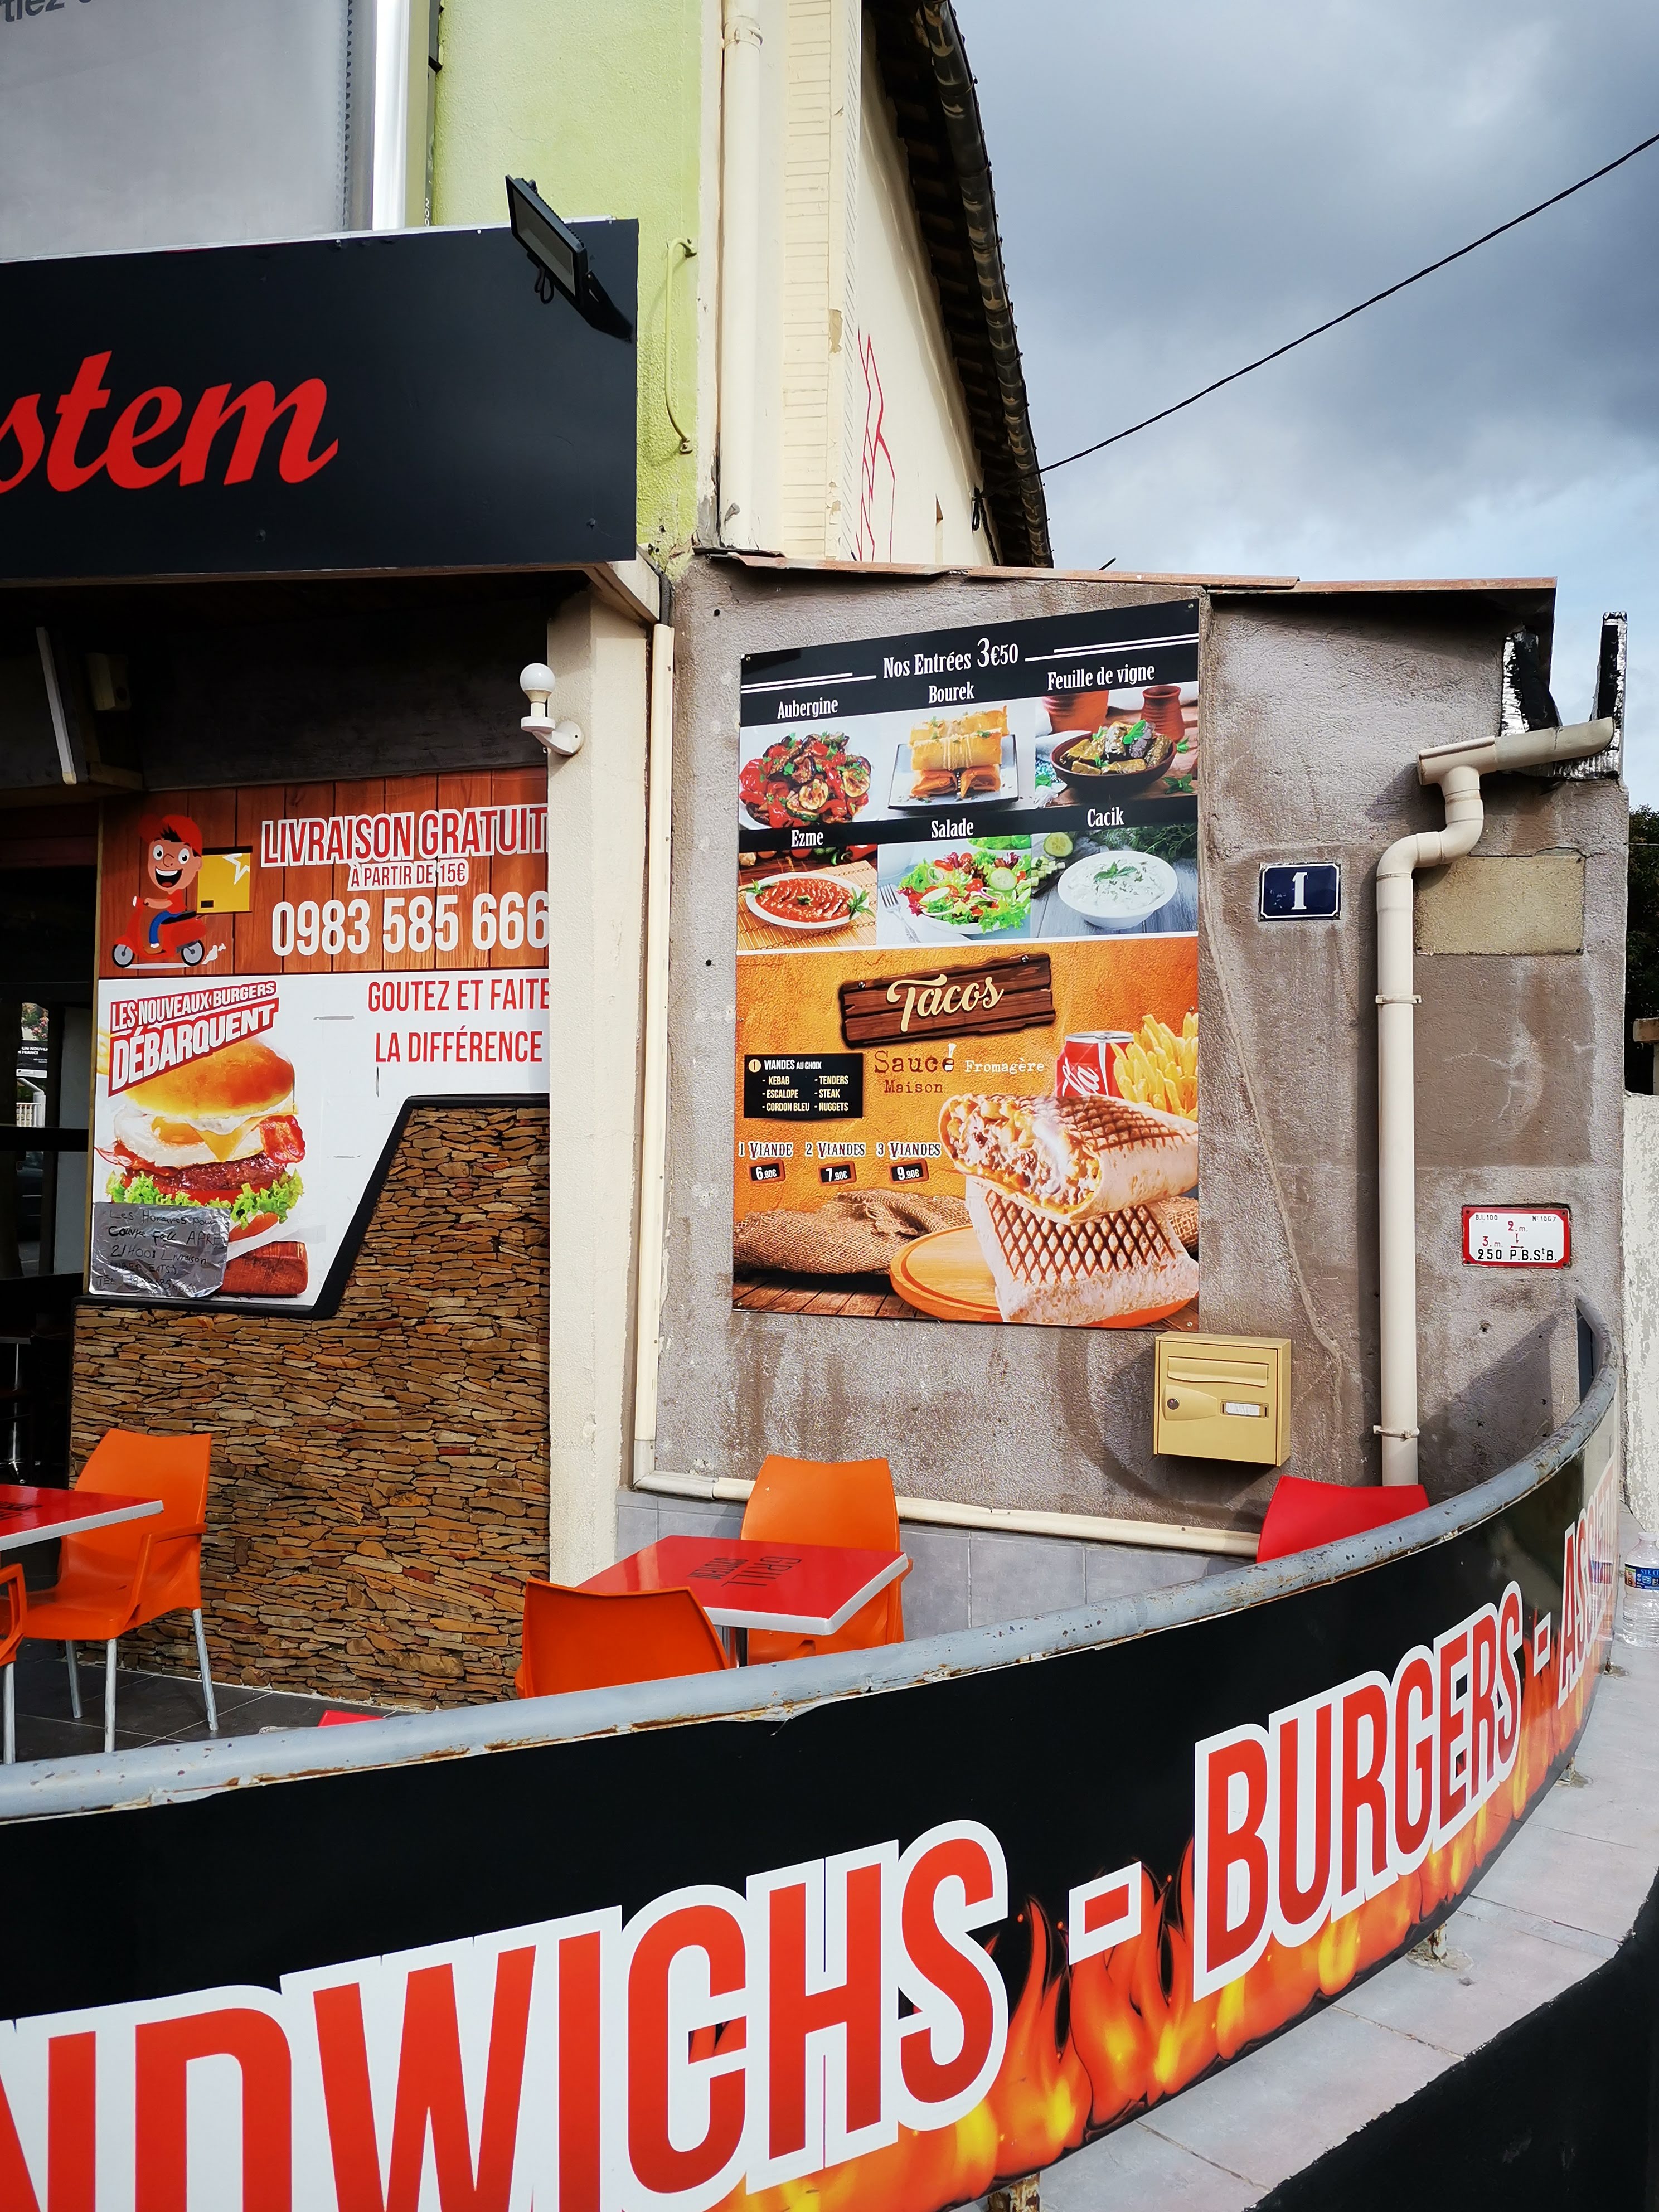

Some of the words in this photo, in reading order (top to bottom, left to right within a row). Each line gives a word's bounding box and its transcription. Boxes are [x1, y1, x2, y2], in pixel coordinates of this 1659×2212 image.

[884, 657, 910, 679] Nos
[914, 651, 971, 676] Entrées
[977, 637, 1018, 667] 3€50
[1047, 668, 1093, 691] Feuille
[1097, 667, 1113, 685] de
[1117, 664, 1155, 685] vigne
[928, 682, 974, 704] Bourek
[777, 696, 838, 719] Aubergine
[1087, 807, 1124, 827] Cacik
[263, 814, 413, 865] LIVRAISON
[420, 806, 549, 858] GRATUIT
[931, 819, 974, 838] Salade
[791, 830, 824, 848] Ezme
[351, 864, 360, 887] À
[365, 866, 411, 886] PARTIR
[416, 865, 433, 884] DE
[440, 864, 465, 883] 15€
[1291, 872, 1308, 910] 1
[272, 899, 370, 957] 0983
[383, 894, 459, 953] 585
[472, 891, 549, 951] 666
[368, 980, 450, 1012] GOUTEZ
[457, 979, 483, 1010] ET
[886, 974, 1005, 1032] Tacos
[112, 1002, 135, 1031] LES
[138, 991, 210, 1025] NOUVEAUX
[214, 983, 275, 1007] BURGERS
[111, 1004, 275, 1091] DÉBARQUENT
[376, 1032, 401, 1062] LA
[408, 1025, 542, 1062] DIFFÉRENCE
[764, 1060, 795, 1070] VIANDES
[804, 1061, 822, 1070] CHOIX
[874, 1050, 955, 1073] Sauce
[964, 1058, 1045, 1074] Fromagère
[768, 1076, 790, 1085] KEBAB
[819, 1076, 848, 1084] TENDERS
[884, 1080, 943, 1094] Maison
[767, 1089, 798, 1098] ESCALOPE
[819, 1089, 840, 1098] STEAK
[767, 1103, 792, 1112] CORDON
[793, 1103, 809, 1112] BLEU
[819, 1102, 848, 1111] NUGGETS
[739, 1143, 744, 1156] 1
[750, 1143, 792, 1157] VIANDE
[806, 1143, 812, 1156] 2
[818, 1143, 865, 1157] VIANDES
[877, 1143, 884, 1156] 3
[890, 1143, 940, 1157] VIANDES
[110, 1210, 134, 1220] Les
[1478, 1249, 1502, 1260] 250
[1199, 1586, 1522, 1987] BURGERS
